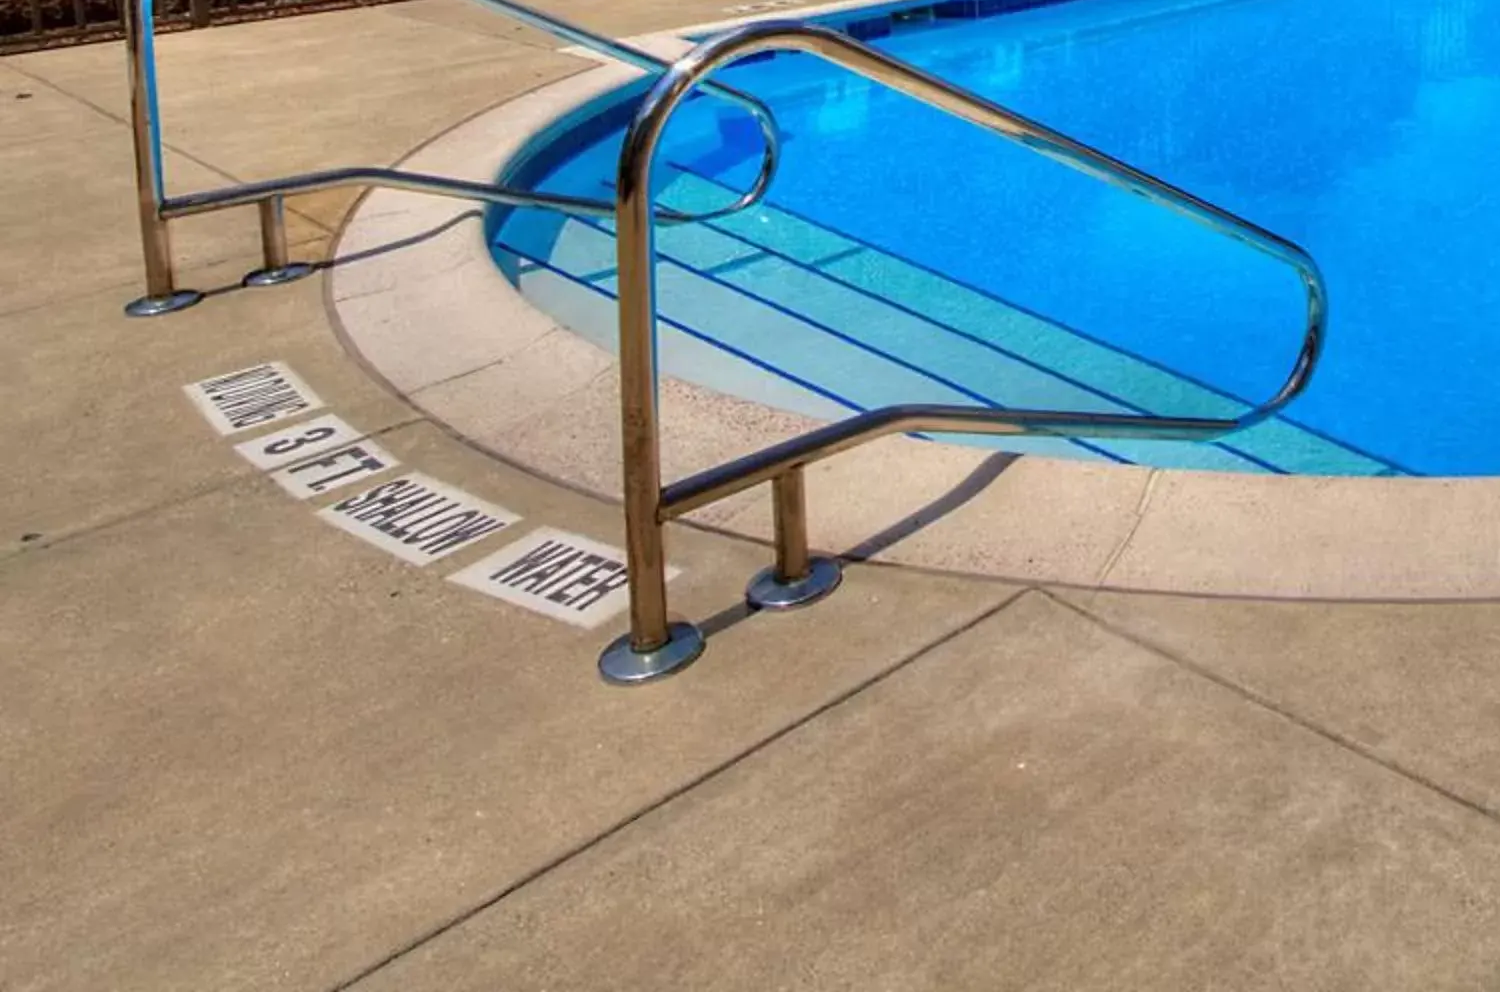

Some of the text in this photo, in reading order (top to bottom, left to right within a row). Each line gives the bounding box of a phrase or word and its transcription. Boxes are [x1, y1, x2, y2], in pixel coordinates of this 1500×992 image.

[264, 427, 336, 456] 3
[333, 478, 507, 555] SHALLOW
[488, 540, 628, 611] WATER
